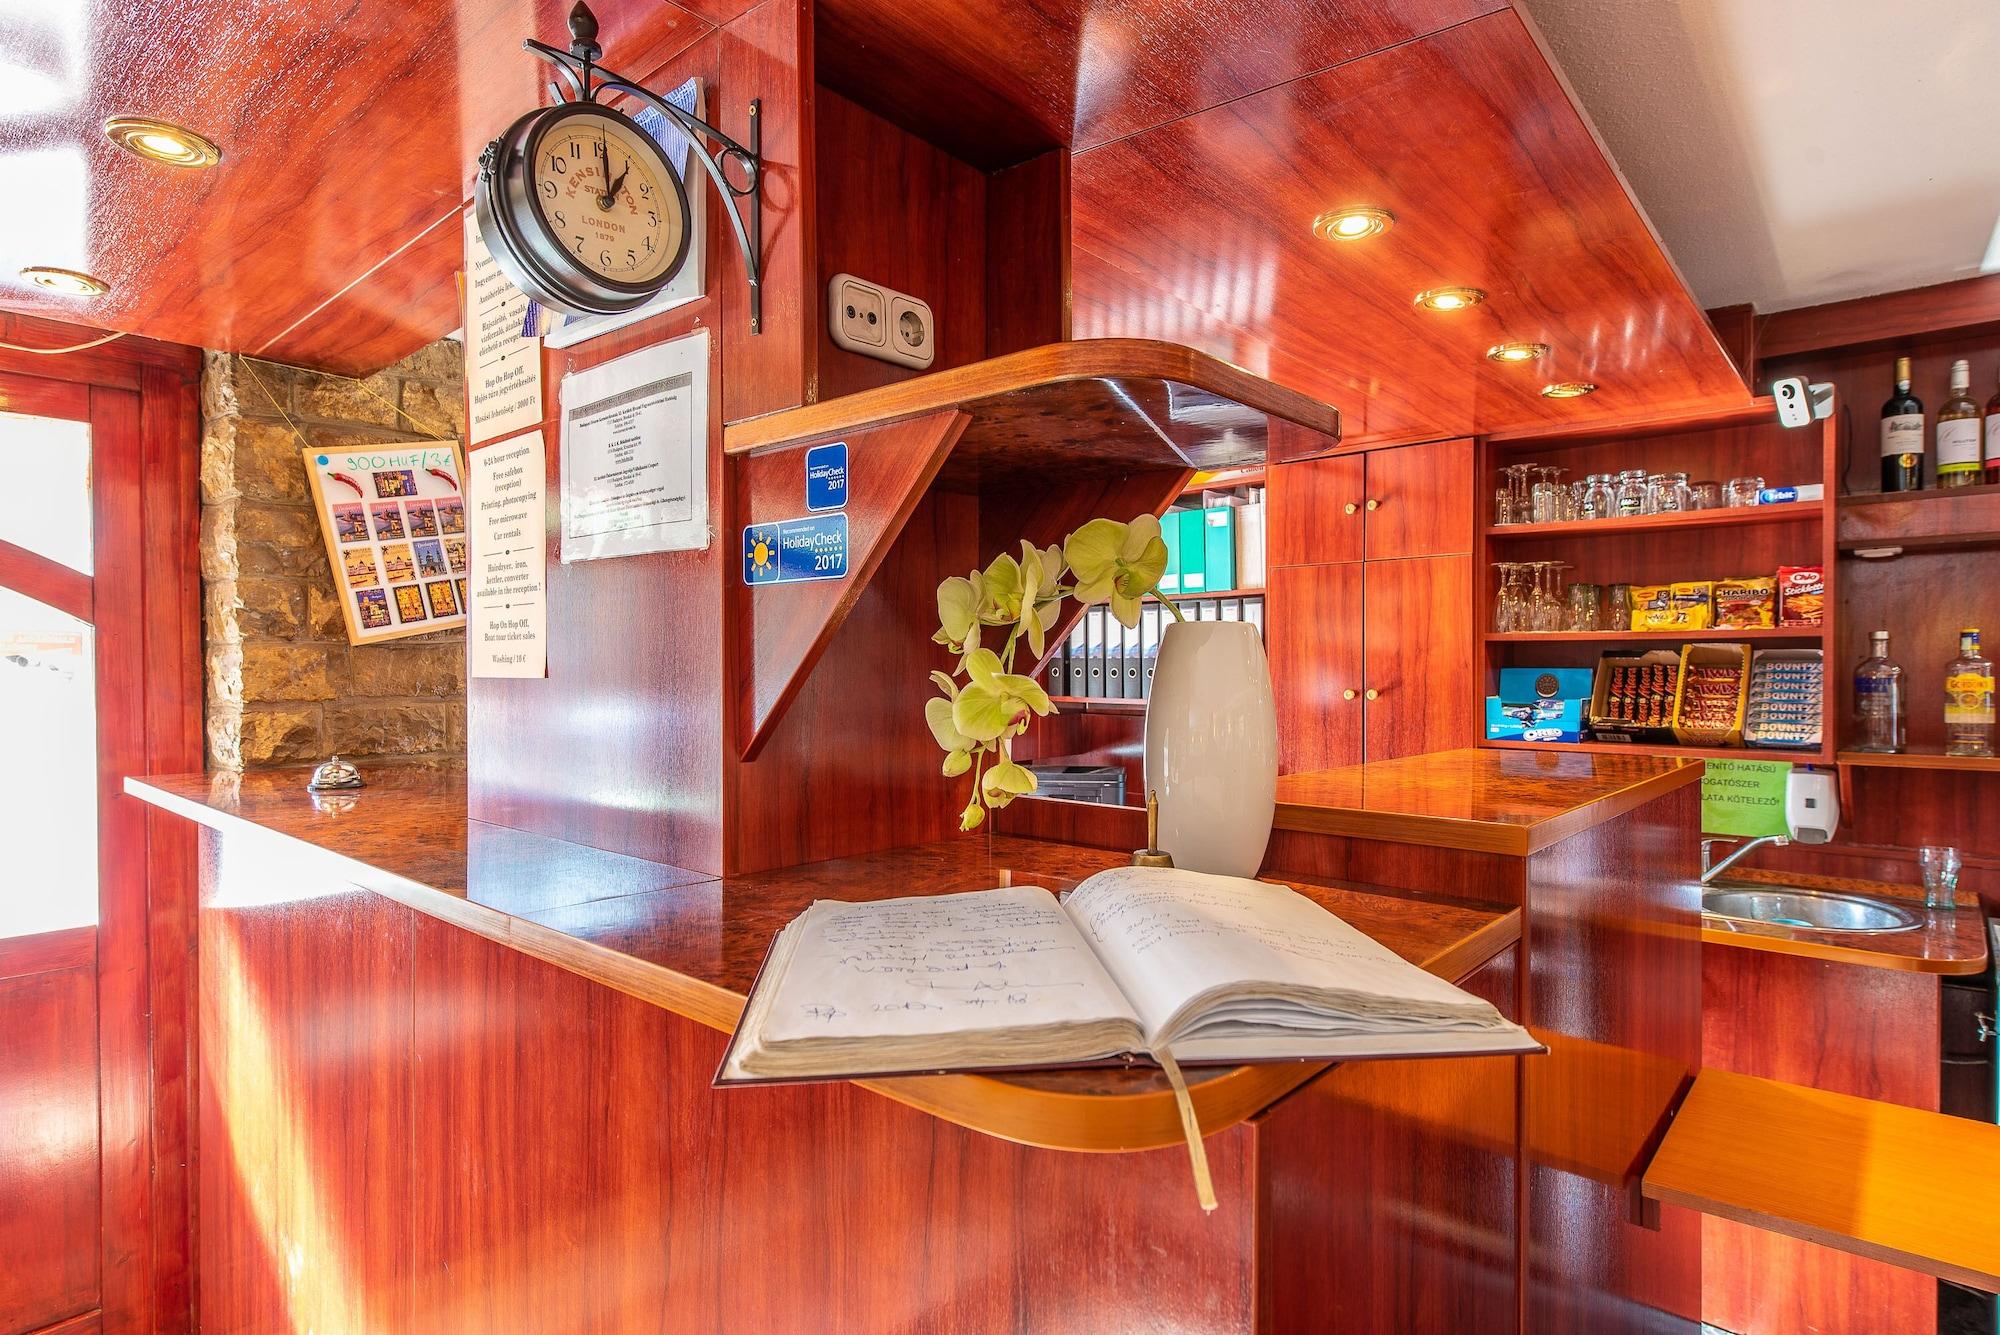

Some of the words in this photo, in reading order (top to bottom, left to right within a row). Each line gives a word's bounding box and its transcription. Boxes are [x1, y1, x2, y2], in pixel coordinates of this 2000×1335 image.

[570, 142, 580, 160] 11
[552, 156, 567, 174] 10
[544, 180, 558, 199] 9
[566, 166, 638, 216] KENSITON
[640, 182, 649, 200] 2
[554, 210, 566, 229] 8
[582, 215, 626, 234] LONDON
[648, 211, 657, 228] 3
[575, 236, 584, 253] 7
[641, 236, 654, 251] 4
[600, 250, 612, 266] 6
[626, 250, 636, 266] 5
[486, 379, 496, 388] Hop
[504, 371, 514, 381] Hop
[506, 446, 530, 460] reception
[492, 472, 504, 480] Free
[810, 466, 844, 480] HolidayCheck
[828, 479, 844, 490] 2017
[488, 516, 500, 526] Free
[500, 512, 528, 524] microwave
[494, 532, 502, 540] Car
[503, 528, 522, 539] rentals
[782, 530, 842, 552] HolidayCheck
[814, 554, 842, 570] 2017
[504, 586, 512, 595] the
[490, 620, 500, 630] Hop
[500, 620, 507, 629] On
[508, 619, 518, 630] Hop
[507, 632, 522, 640] ticket
[522, 630, 536, 640] sales
[1698, 668, 1740, 678] TWIX
[1766, 662, 1817, 670] BOUNTY
[1651, 664, 1664, 696] Mars
[1694, 684, 1739, 696] TWIX
[1761, 702, 1812, 712] BOUNTY
[1524, 728, 1562, 740] OREO
[1760, 722, 1812, 732] BOUNTY
[1756, 732, 1810, 740] BOUNTY
[1706, 762, 1734, 771] ENÍTŐ
[1738, 764, 1777, 773] HATÁSÚ
[1701, 793, 1724, 802] LATA
